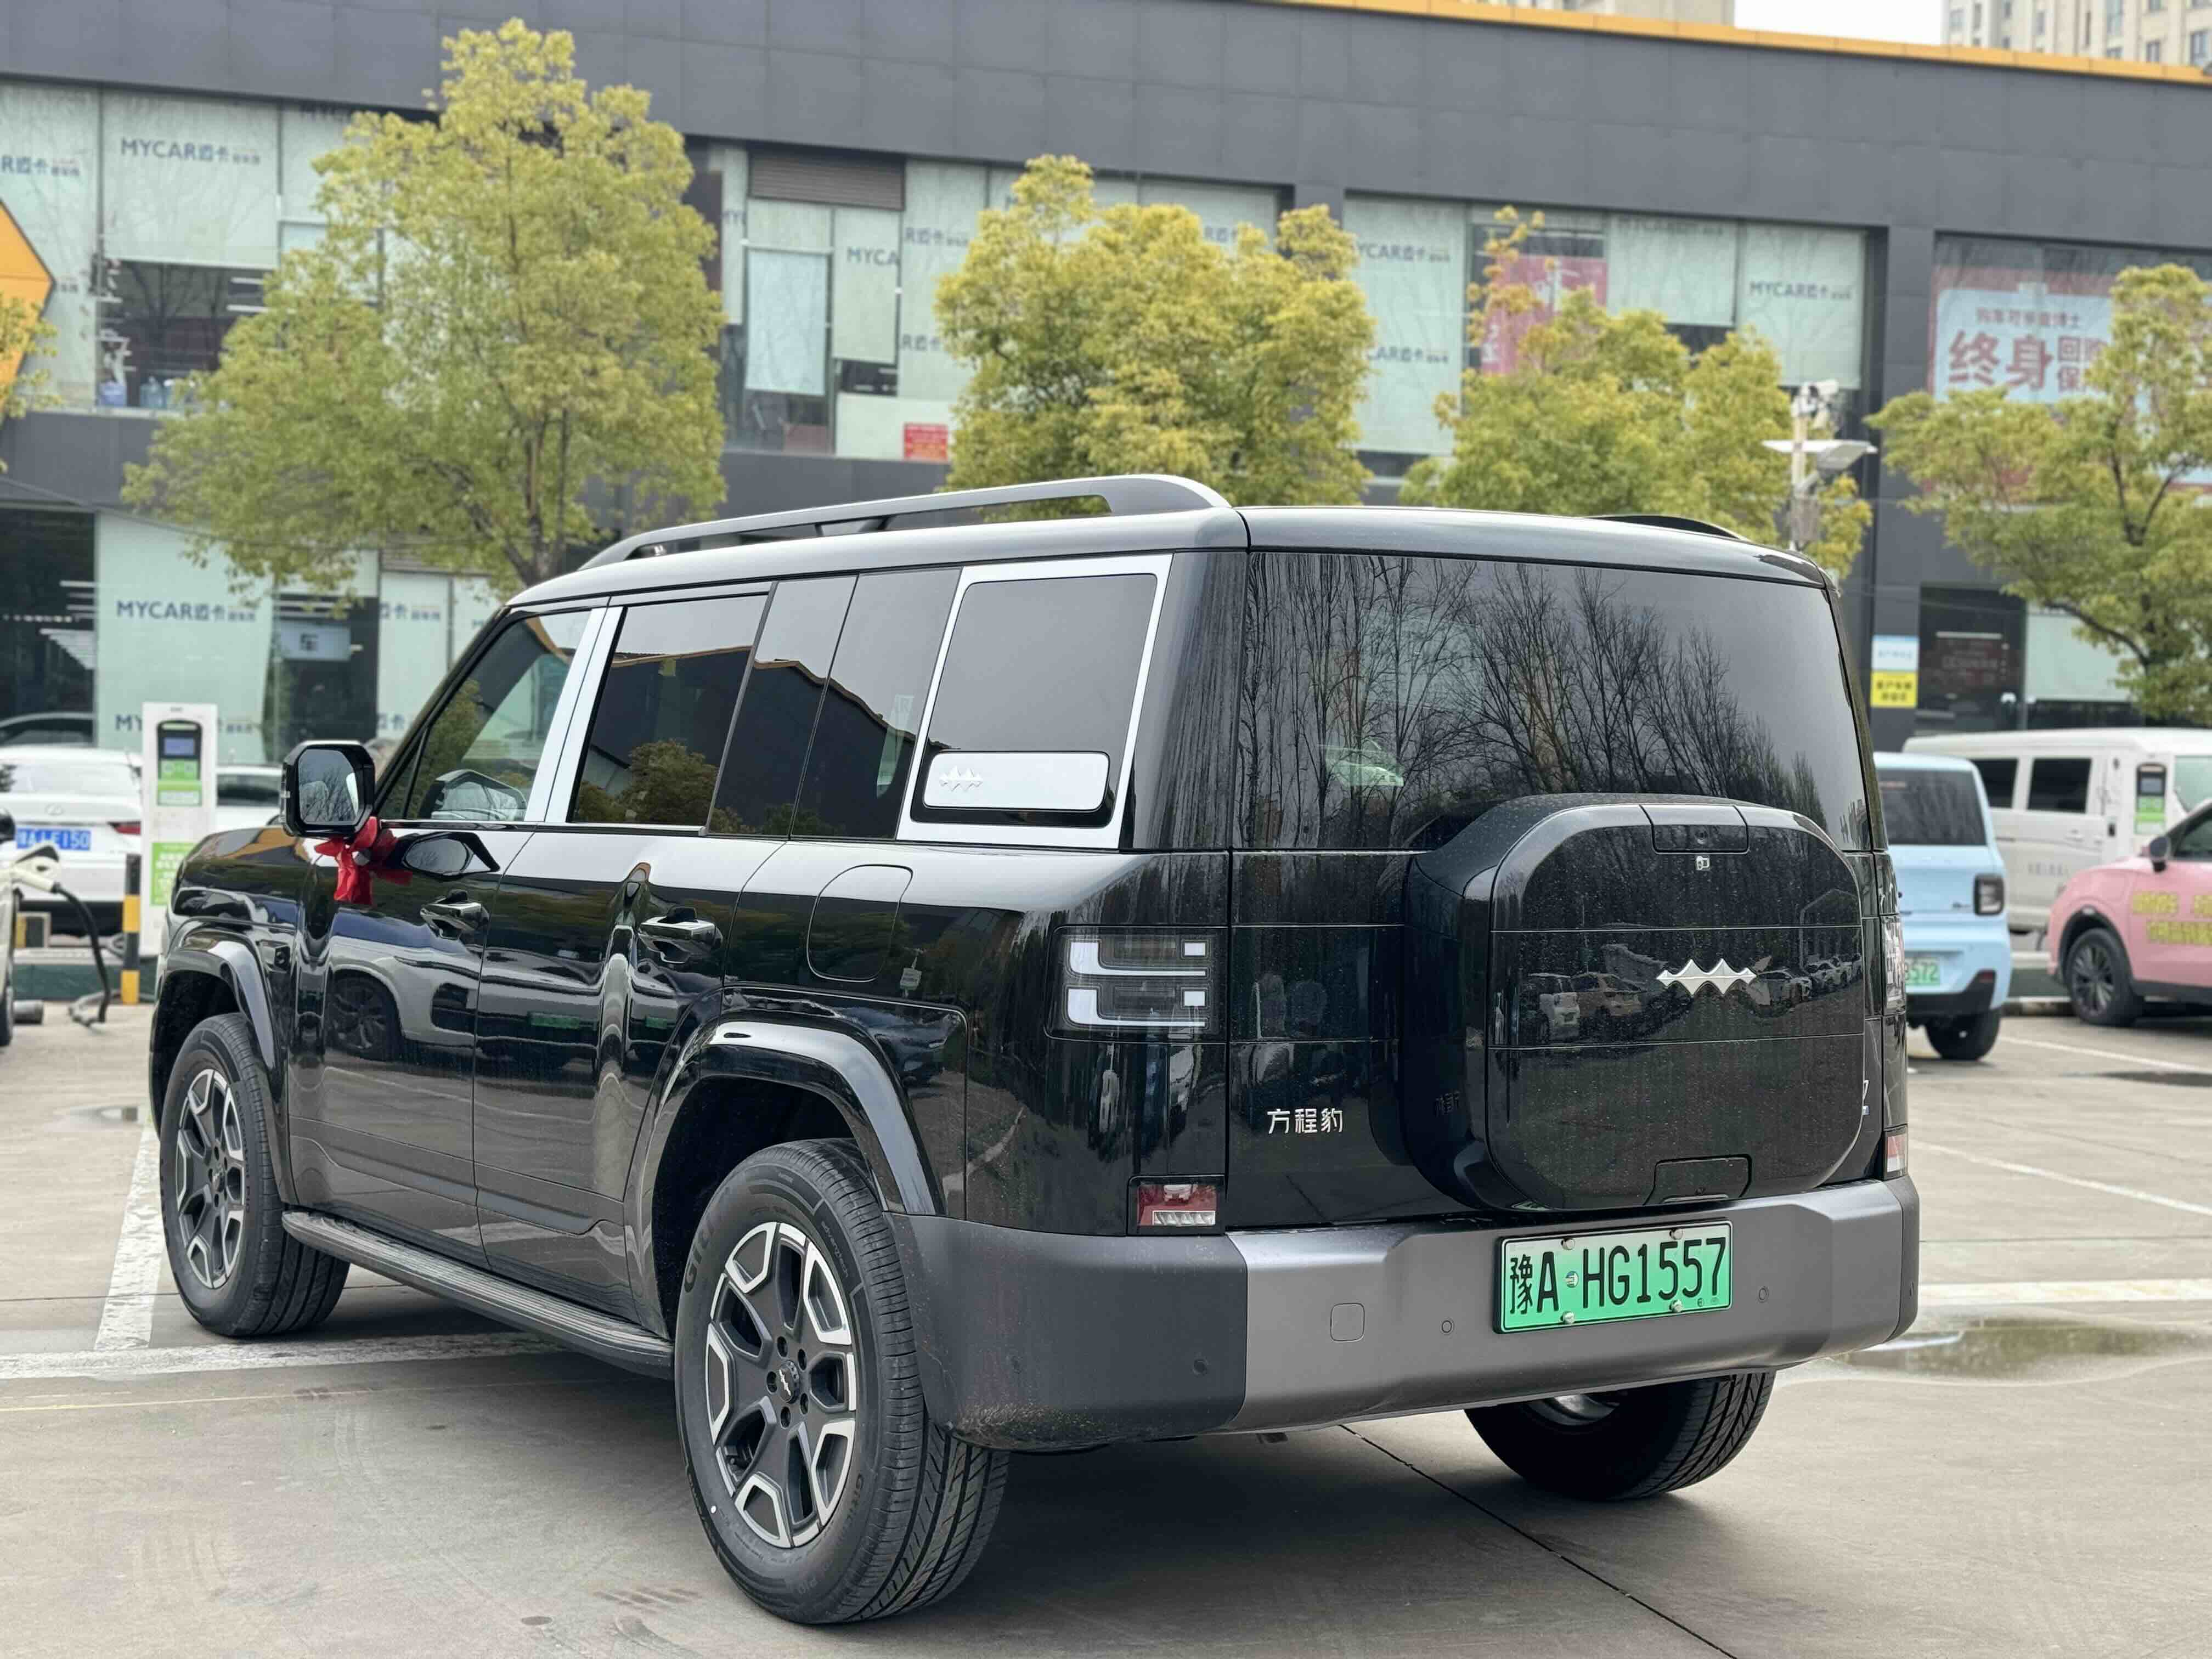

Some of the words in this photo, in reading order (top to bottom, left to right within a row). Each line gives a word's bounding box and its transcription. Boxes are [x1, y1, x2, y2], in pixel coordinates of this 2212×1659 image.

[1948, 330, 2054, 391] 终身
[1267, 1108, 1343, 1134] 方程豹
[1509, 1251, 1559, 1315] 豫A
[1583, 1237, 1726, 1308] HG1557
